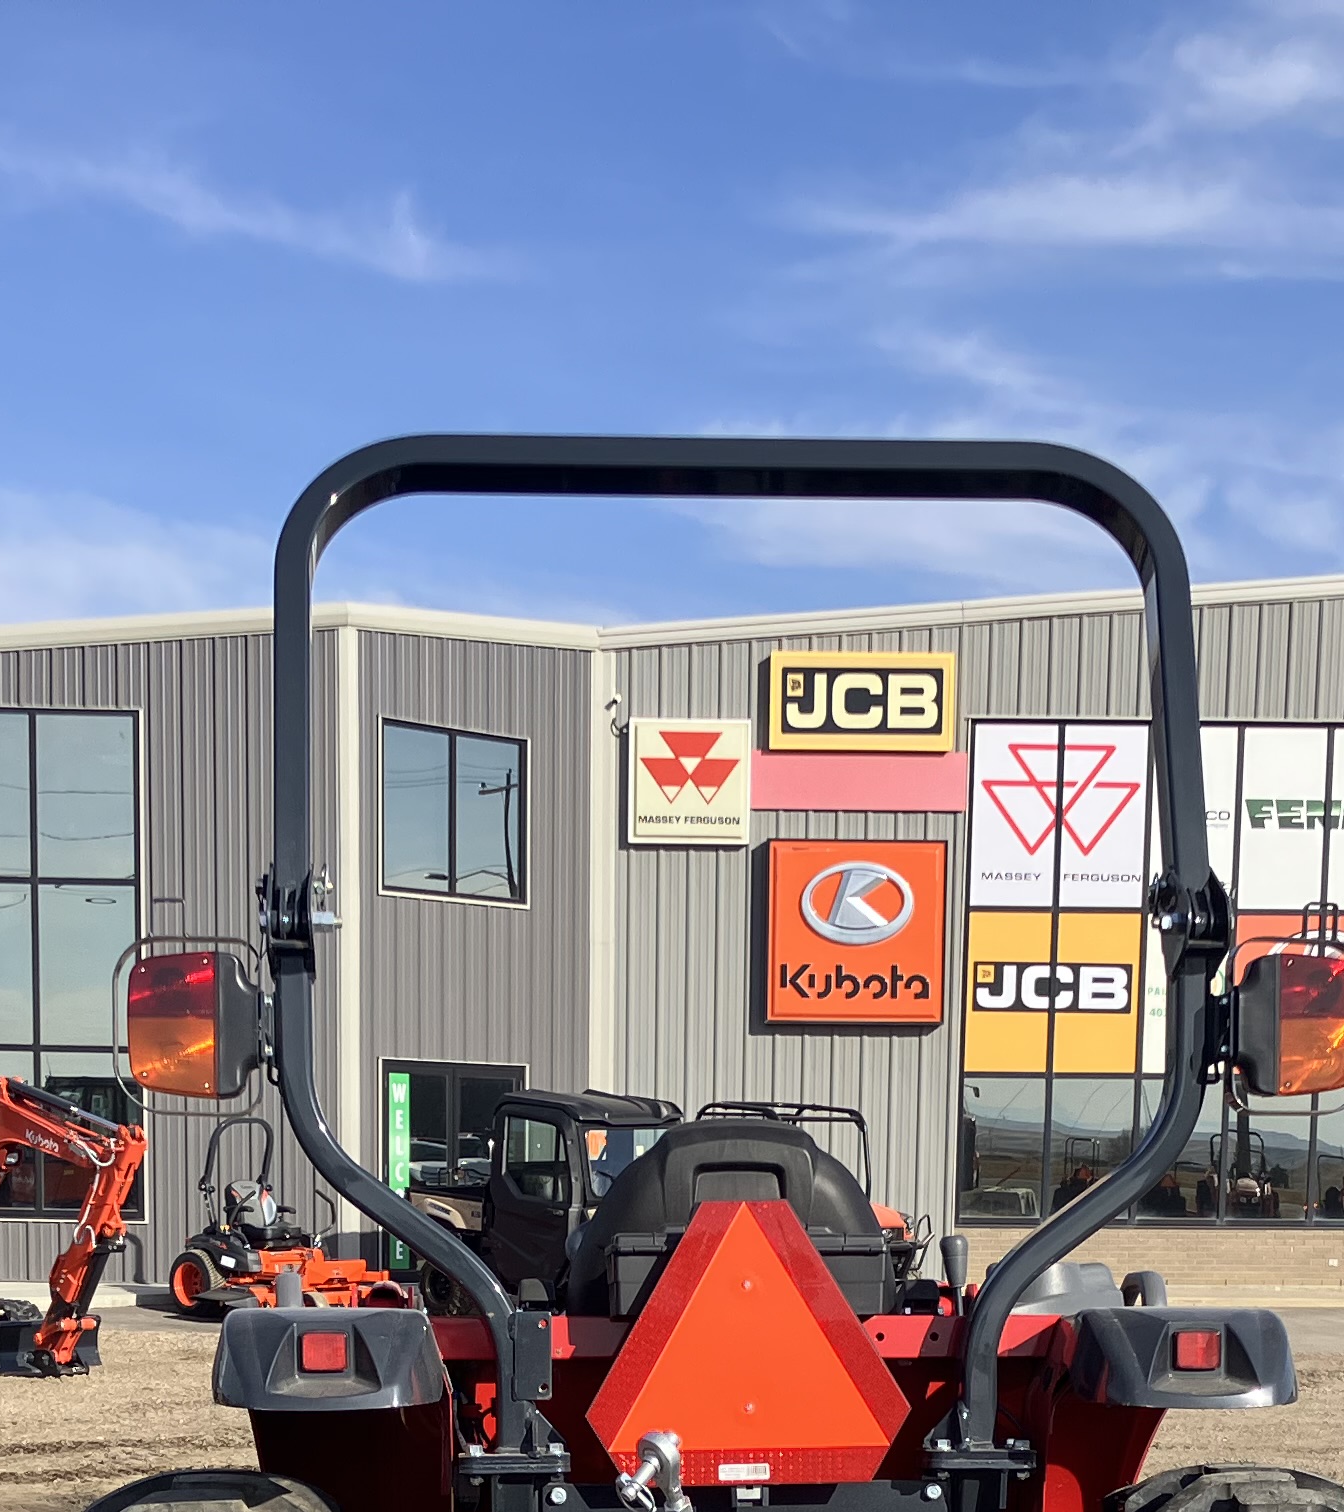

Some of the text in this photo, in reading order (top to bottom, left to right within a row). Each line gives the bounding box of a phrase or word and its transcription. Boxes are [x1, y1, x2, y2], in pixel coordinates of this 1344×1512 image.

[786, 672, 939, 729] JCB
[638, 815, 740, 826] MASSEY FERGUSON
[981, 872, 1142, 883] MASSEY FERGUSON
[779, 963, 930, 1000] Kubota
[976, 964, 1129, 1010] JCB
[25, 1128, 59, 1153] Kubota
[392, 1082, 407, 1260] WELCE
